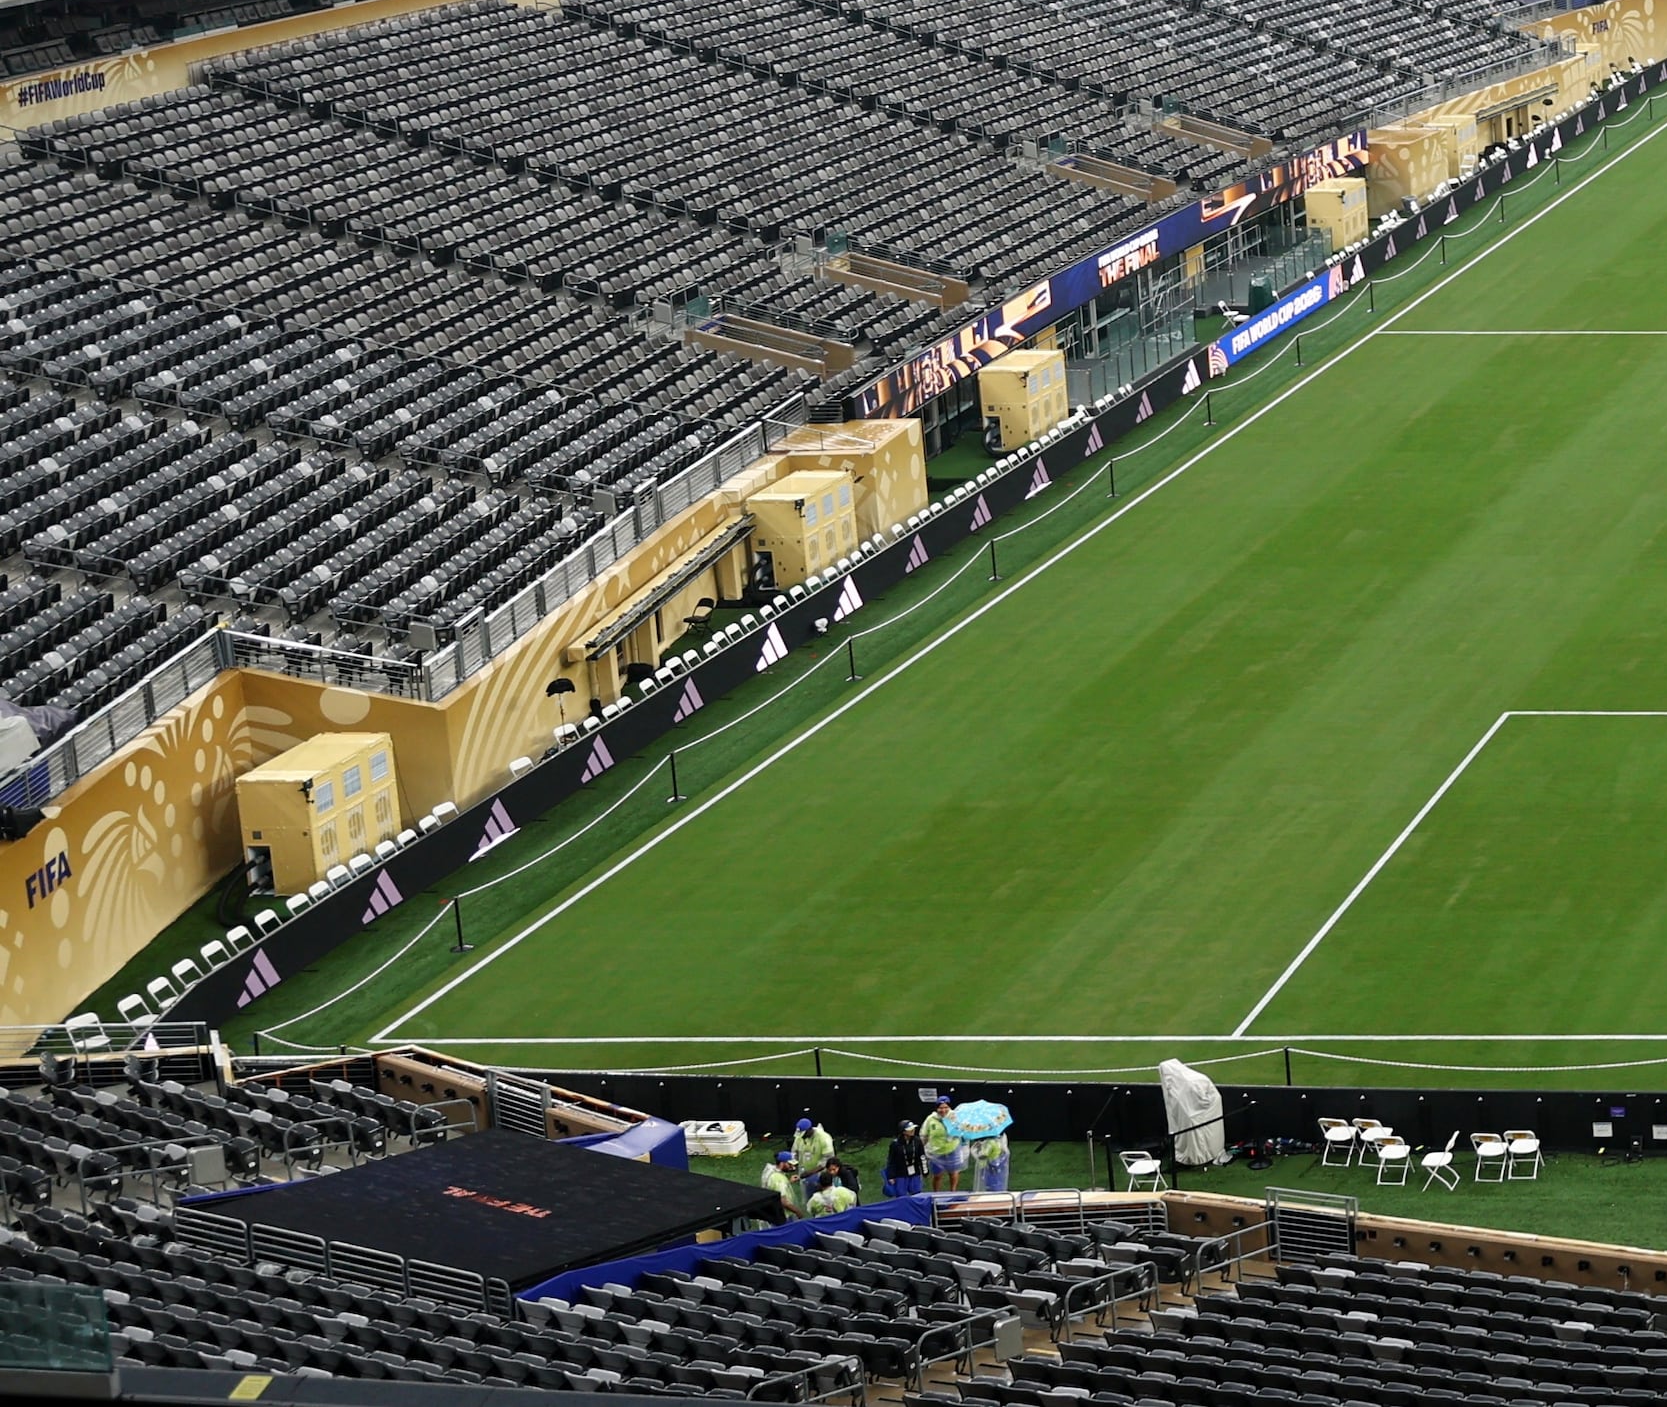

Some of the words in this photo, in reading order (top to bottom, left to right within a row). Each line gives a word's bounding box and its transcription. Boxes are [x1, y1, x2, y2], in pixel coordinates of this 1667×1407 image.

[1592, 19, 1610, 34] FIFA
[18, 71, 106, 108] #FIFAWorldCup
[1098, 259, 1124, 288] THE
[1124, 241, 1160, 275] FINAL
[1232, 330, 1250, 355] FIFA
[1249, 312, 1279, 343] WORLD
[1278, 302, 1295, 324] CUP
[1294, 285, 1322, 315] 2026
[25, 851, 73, 910] FIFA
